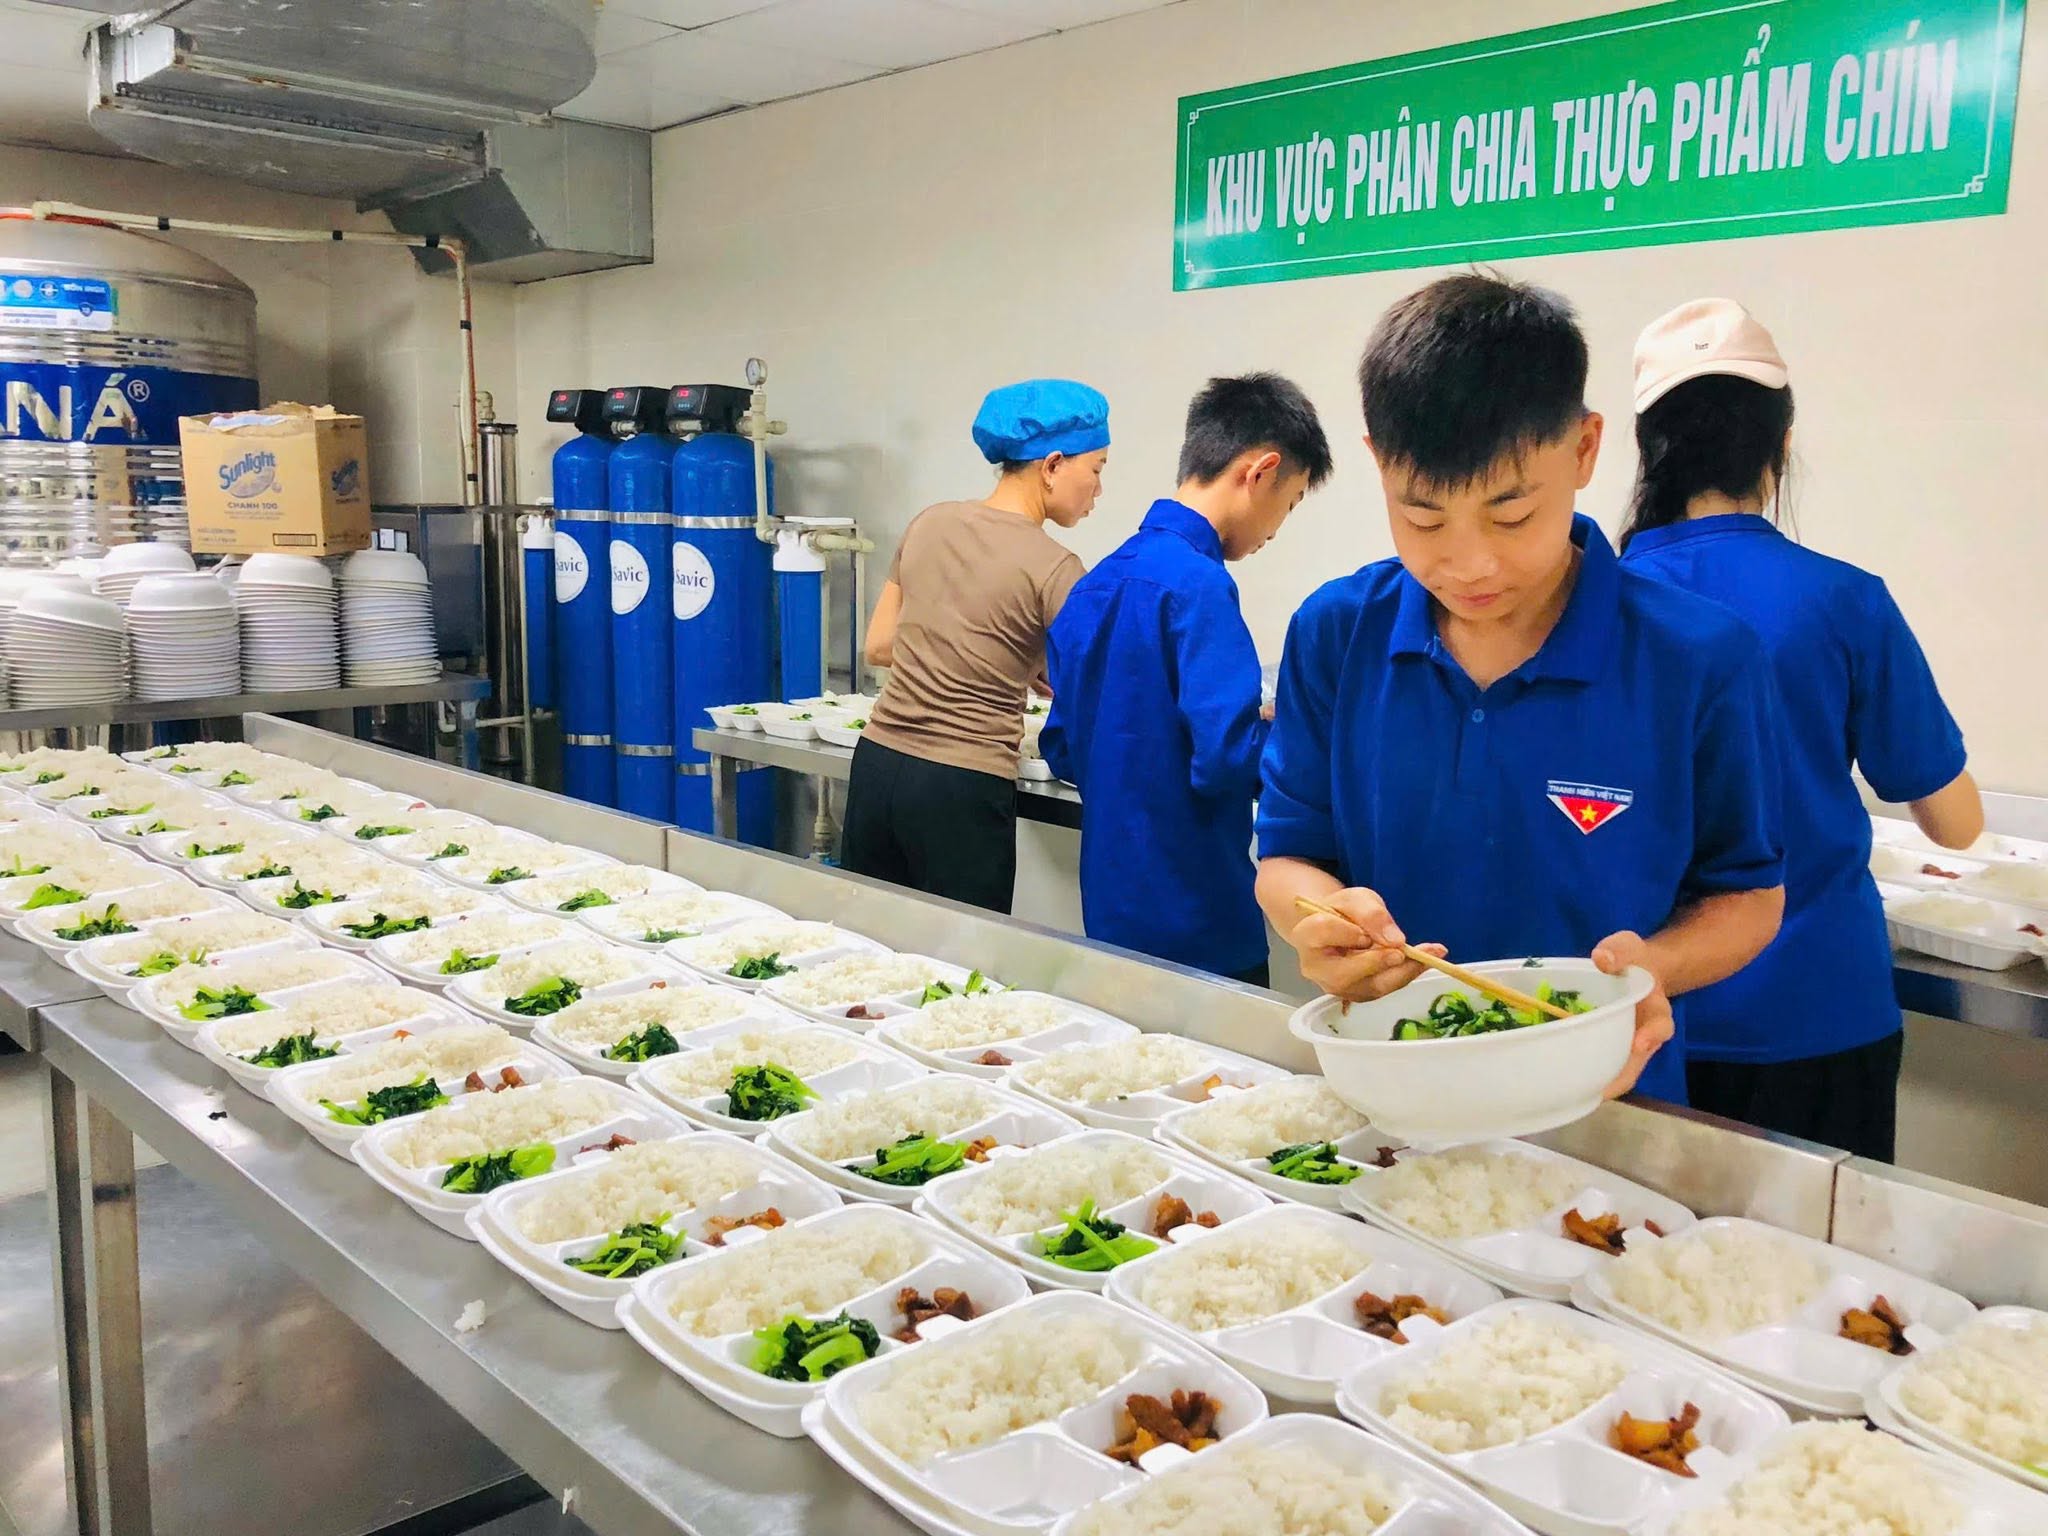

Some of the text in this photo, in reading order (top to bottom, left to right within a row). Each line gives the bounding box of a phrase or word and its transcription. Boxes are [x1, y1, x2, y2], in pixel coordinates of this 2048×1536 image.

[1206, 19, 1957, 245] KHU VỰC PHÂN CHIA THỰC PHẨM CHÍN
[219, 451, 276, 490] Sunlight
[676, 570, 708, 588] Savic
